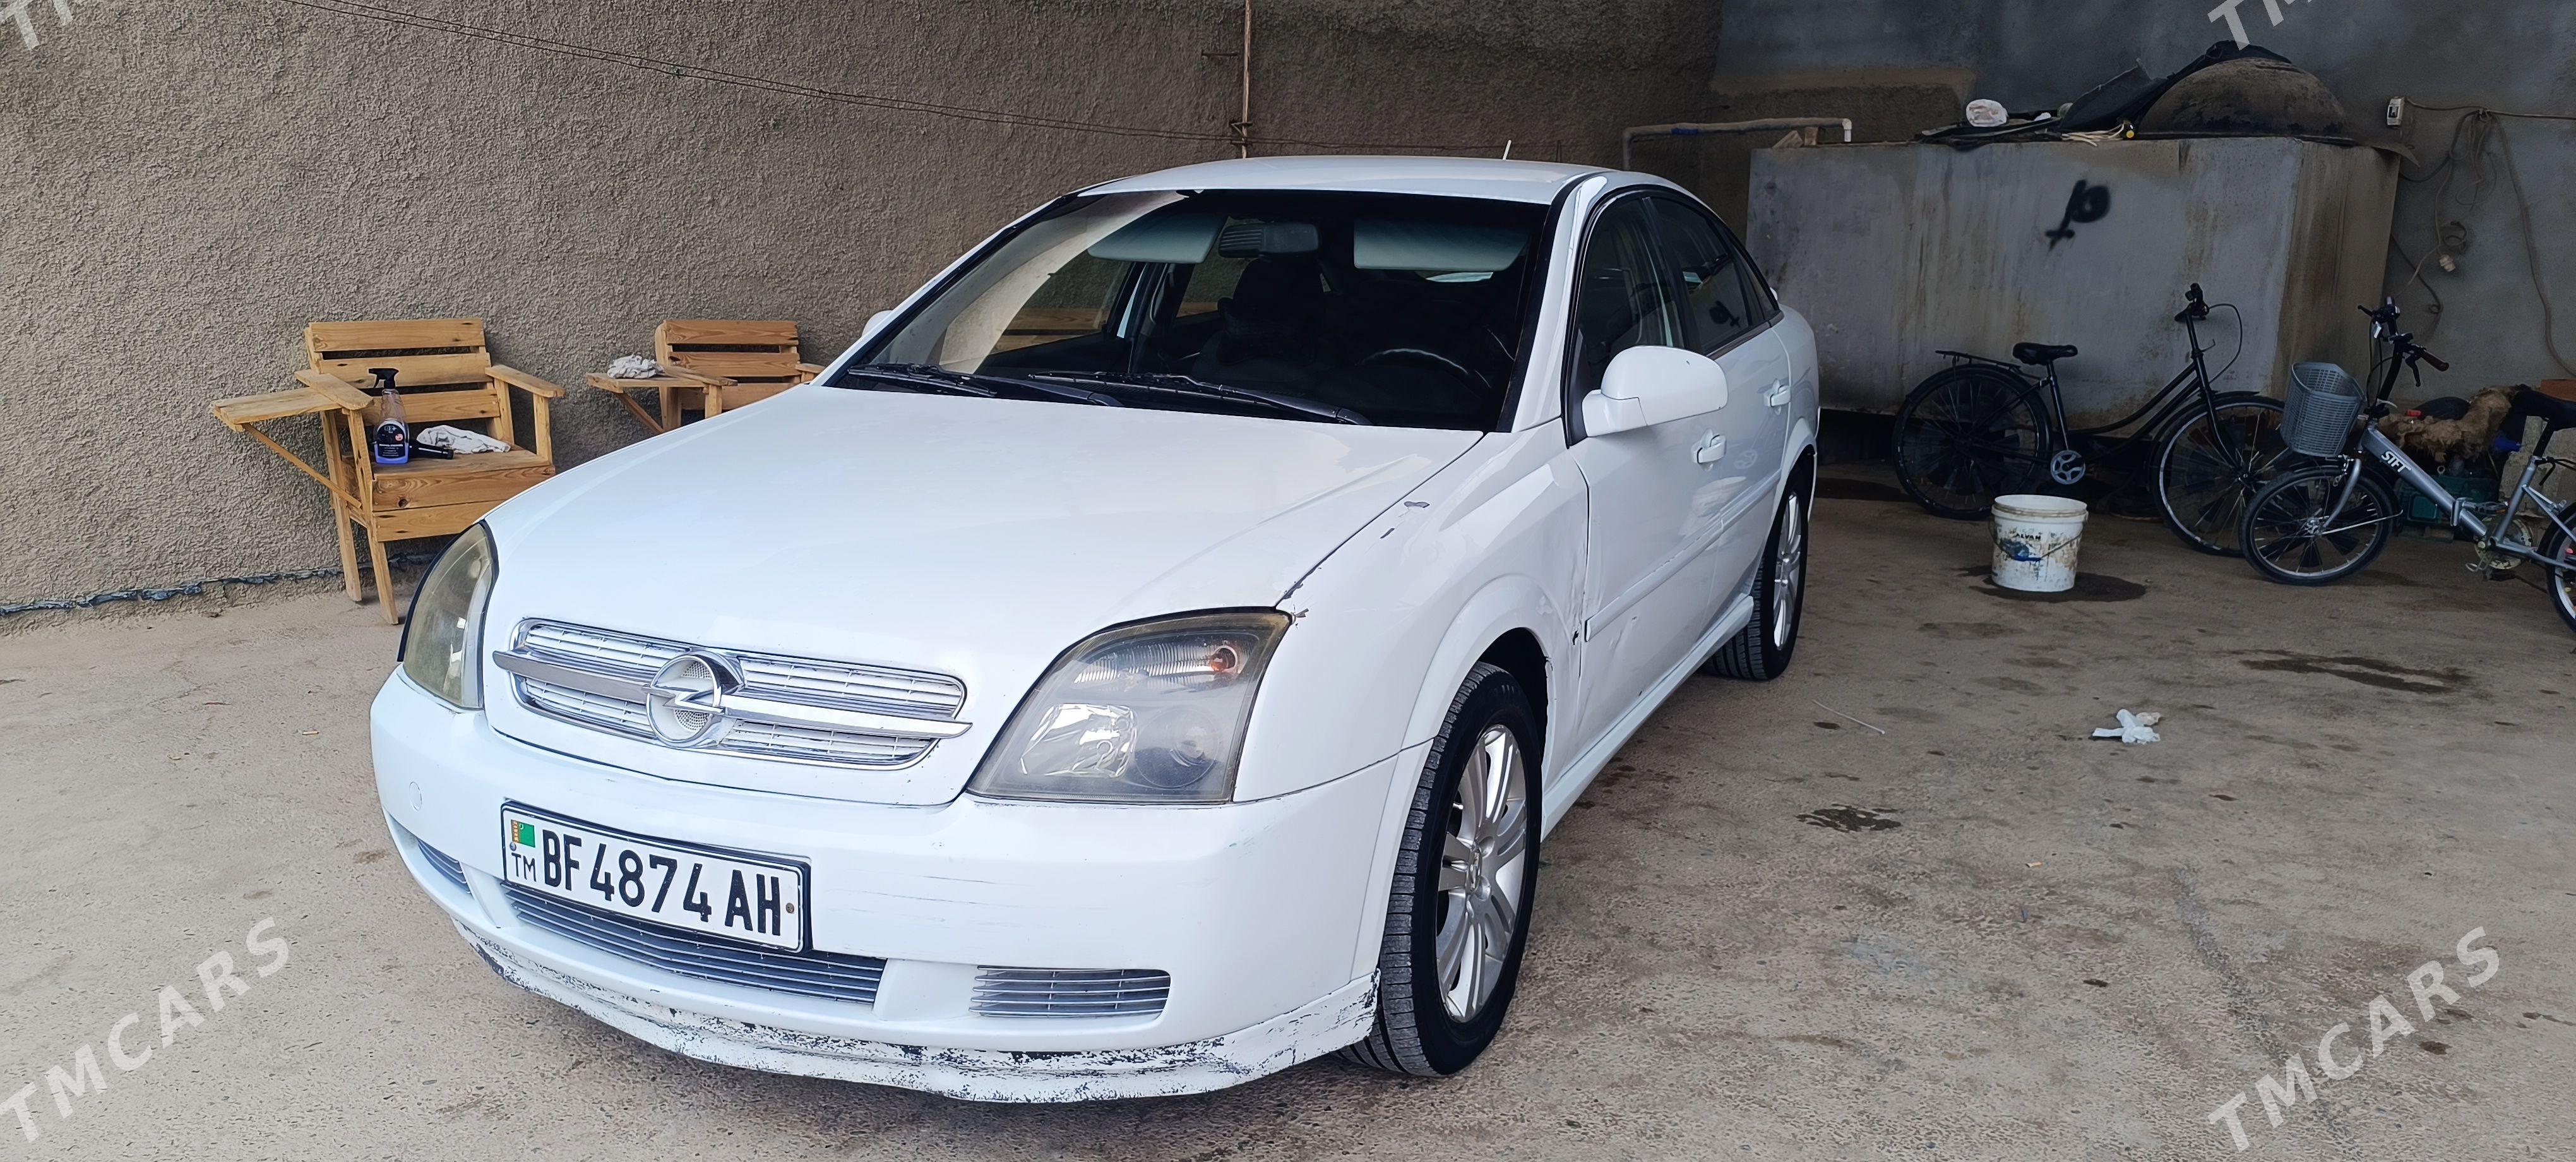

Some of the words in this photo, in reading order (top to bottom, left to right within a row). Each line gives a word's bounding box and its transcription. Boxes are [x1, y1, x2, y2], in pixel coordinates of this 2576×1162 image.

[511, 852, 536, 882] TM
[542, 829, 582, 891] BF
[590, 843, 712, 923] 4874
[724, 870, 781, 937] AH
